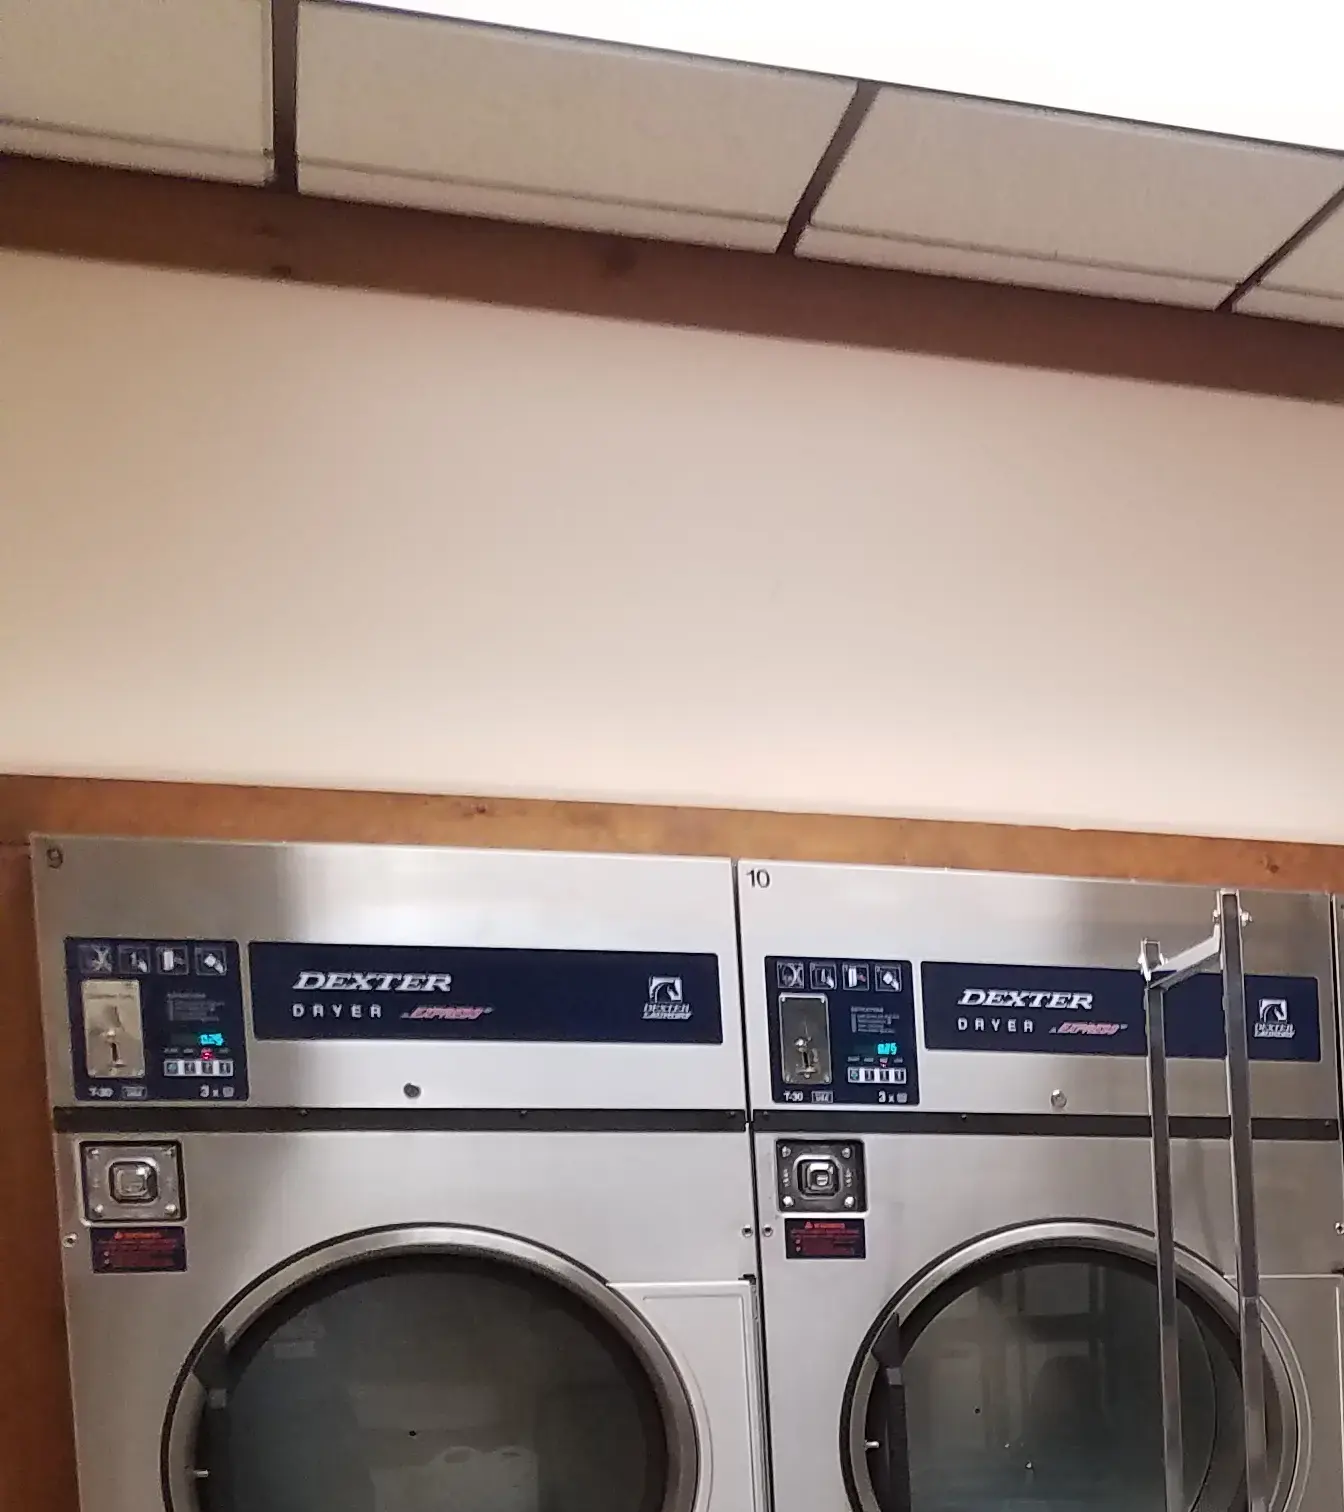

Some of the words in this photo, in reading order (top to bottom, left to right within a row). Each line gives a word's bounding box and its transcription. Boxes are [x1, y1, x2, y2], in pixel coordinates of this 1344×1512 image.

[46, 848, 63, 869] 9
[747, 869, 770, 888] 10
[292, 971, 452, 992] DEXTER
[957, 988, 1093, 1010] DEXTER
[292, 1003, 382, 1019] DRYER
[957, 1017, 1034, 1033] DRYER
